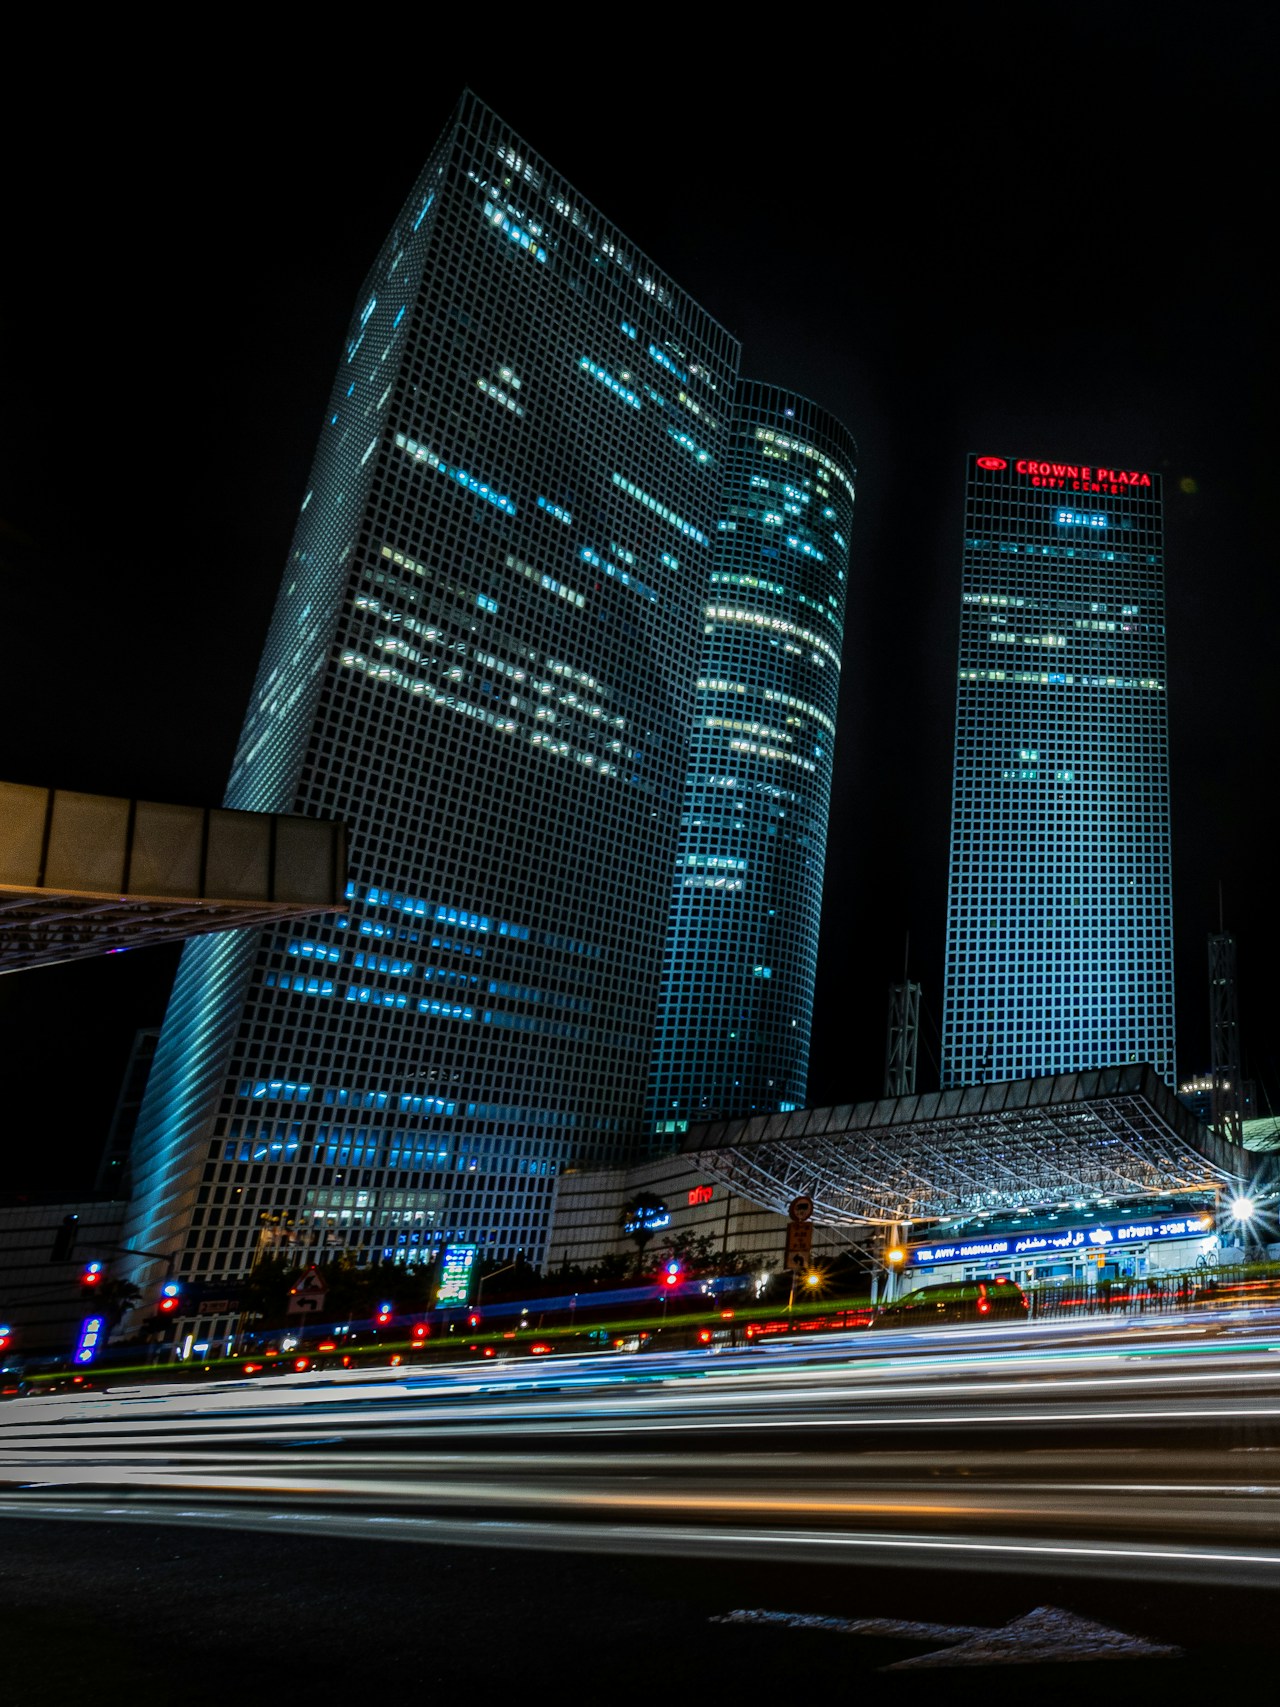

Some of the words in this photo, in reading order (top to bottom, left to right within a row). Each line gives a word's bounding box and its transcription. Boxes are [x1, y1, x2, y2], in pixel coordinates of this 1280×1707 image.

[1016, 460, 1090, 480] CROWNE
[1097, 468, 1151, 487] PLAZA
[1032, 477, 1064, 488] CITY
[1118, 1226, 1153, 1239] השלום
[917, 1250, 934, 1261] TEL
[935, 1248, 955, 1259] AVIV
[961, 1242, 1008, 1256] HASHALOM
